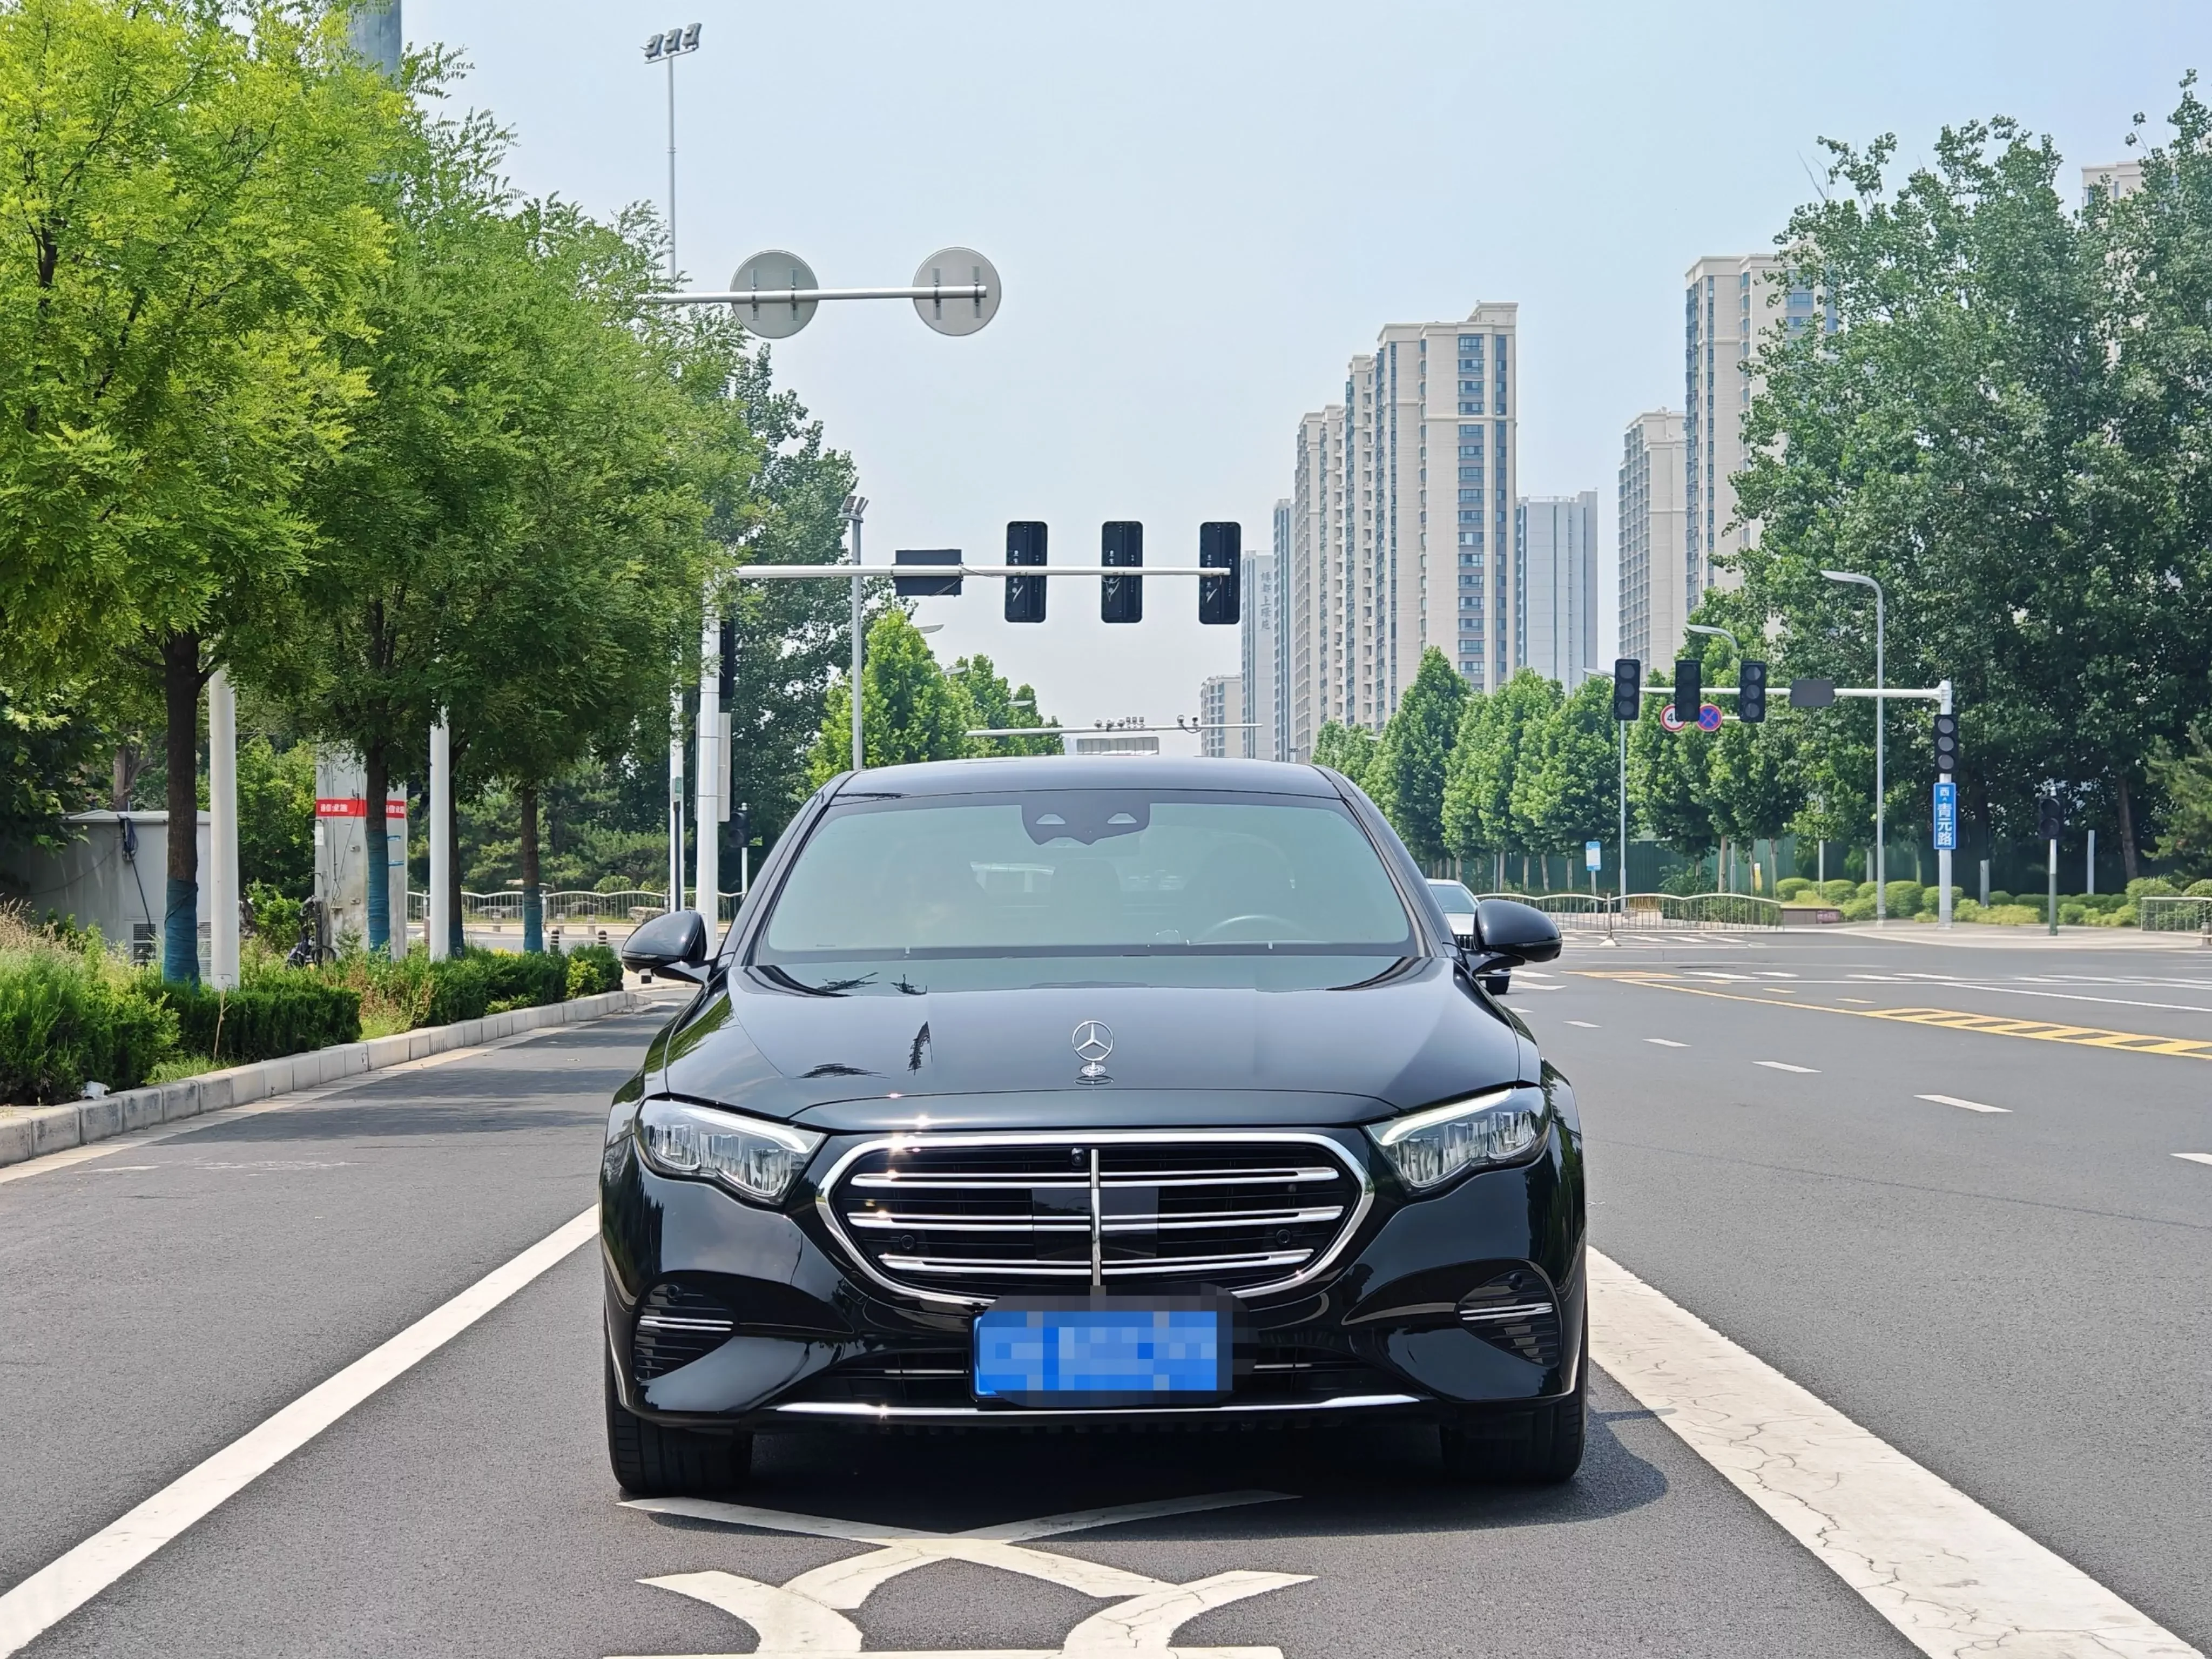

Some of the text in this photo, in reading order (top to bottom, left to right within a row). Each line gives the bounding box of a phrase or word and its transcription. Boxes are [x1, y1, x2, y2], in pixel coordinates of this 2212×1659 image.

[1667, 713, 1674, 723] 4
[1937, 803, 1953, 846] 青元路
